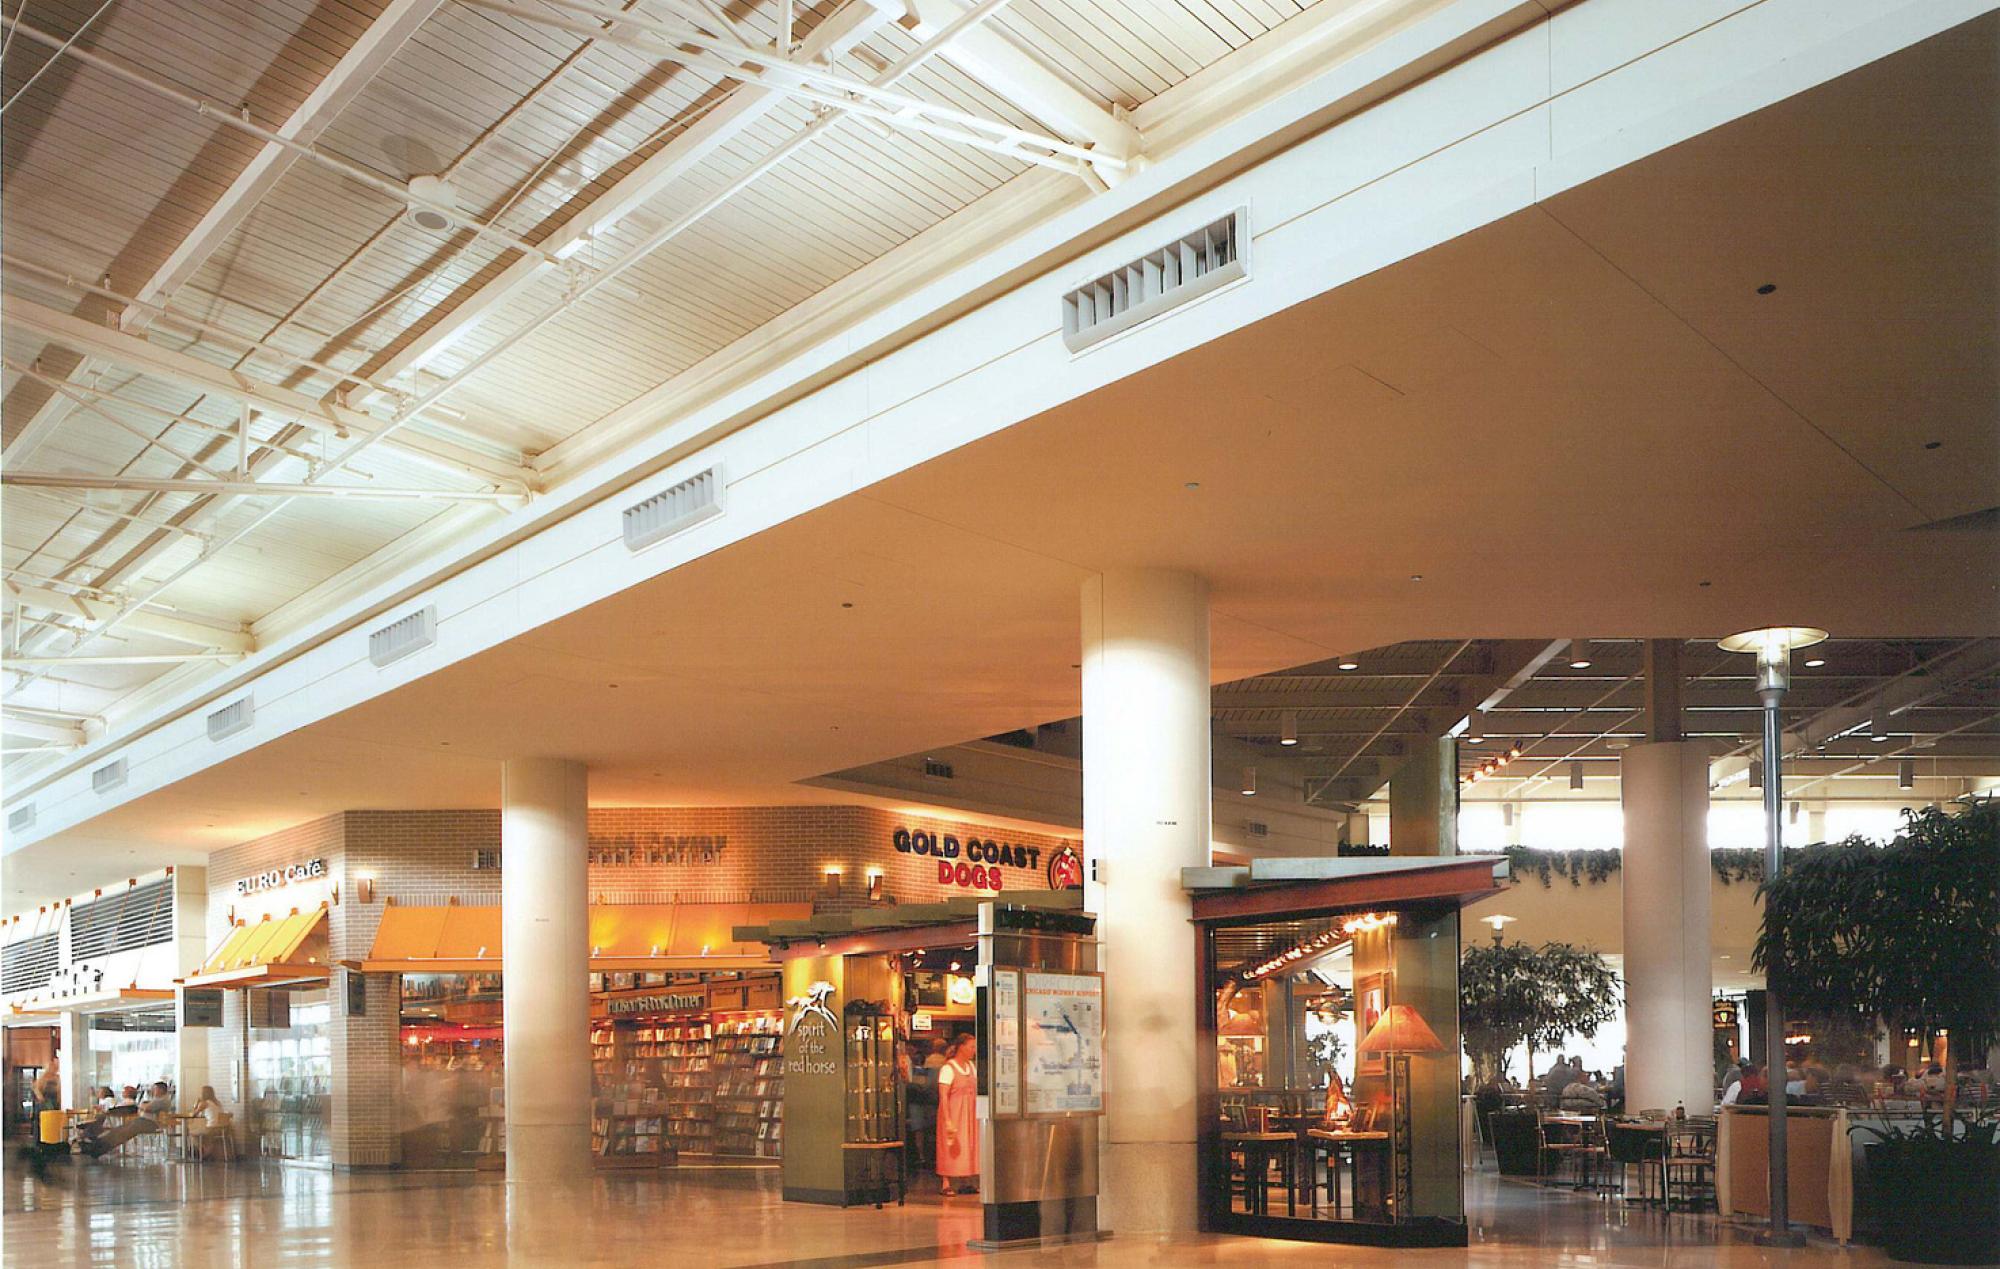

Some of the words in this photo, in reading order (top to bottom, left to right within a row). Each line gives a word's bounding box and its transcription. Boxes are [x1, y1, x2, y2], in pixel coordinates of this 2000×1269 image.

[893, 829, 960, 858] GOLD
[967, 840, 1041, 869] COAST
[236, 869, 280, 893] EURO
[938, 860, 1003, 891] DOGS
[797, 1021, 825, 1042] spirit
[799, 1039, 810, 1054] of
[810, 1040, 825, 1054] the
[789, 1055, 804, 1074] red
[805, 1055, 836, 1074] horse
